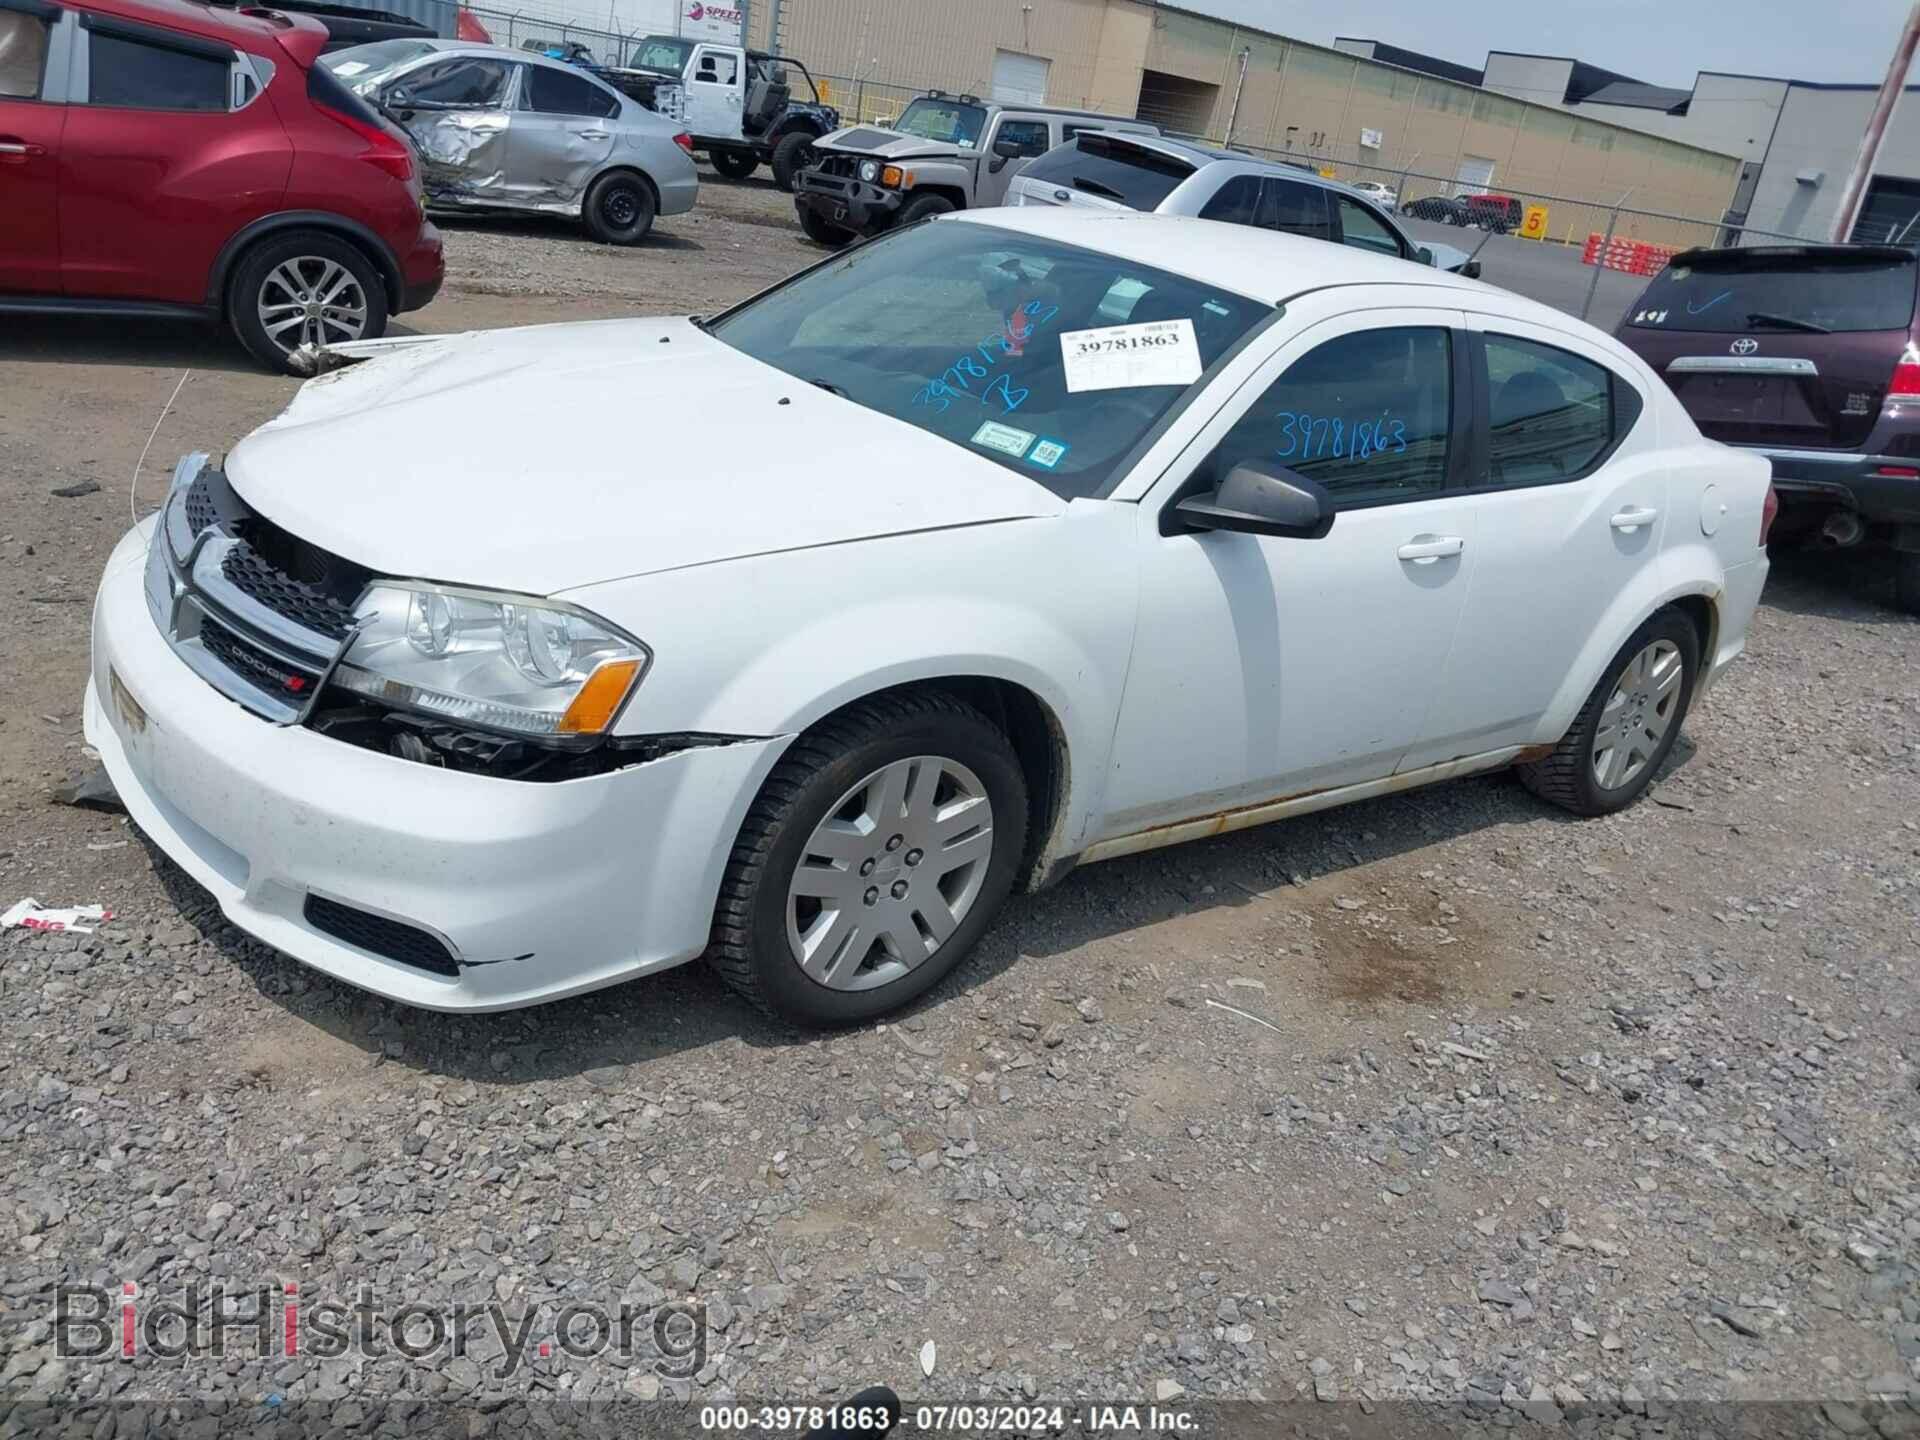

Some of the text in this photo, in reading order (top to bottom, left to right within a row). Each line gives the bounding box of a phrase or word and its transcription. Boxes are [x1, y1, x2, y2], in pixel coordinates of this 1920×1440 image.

[704, 6, 742, 21] SPEED
[1528, 213, 1541, 231] 5
[1077, 333, 1180, 358] 39781863
[1276, 412, 1407, 462] 39781863
[231, 646, 289, 684] DODGE
